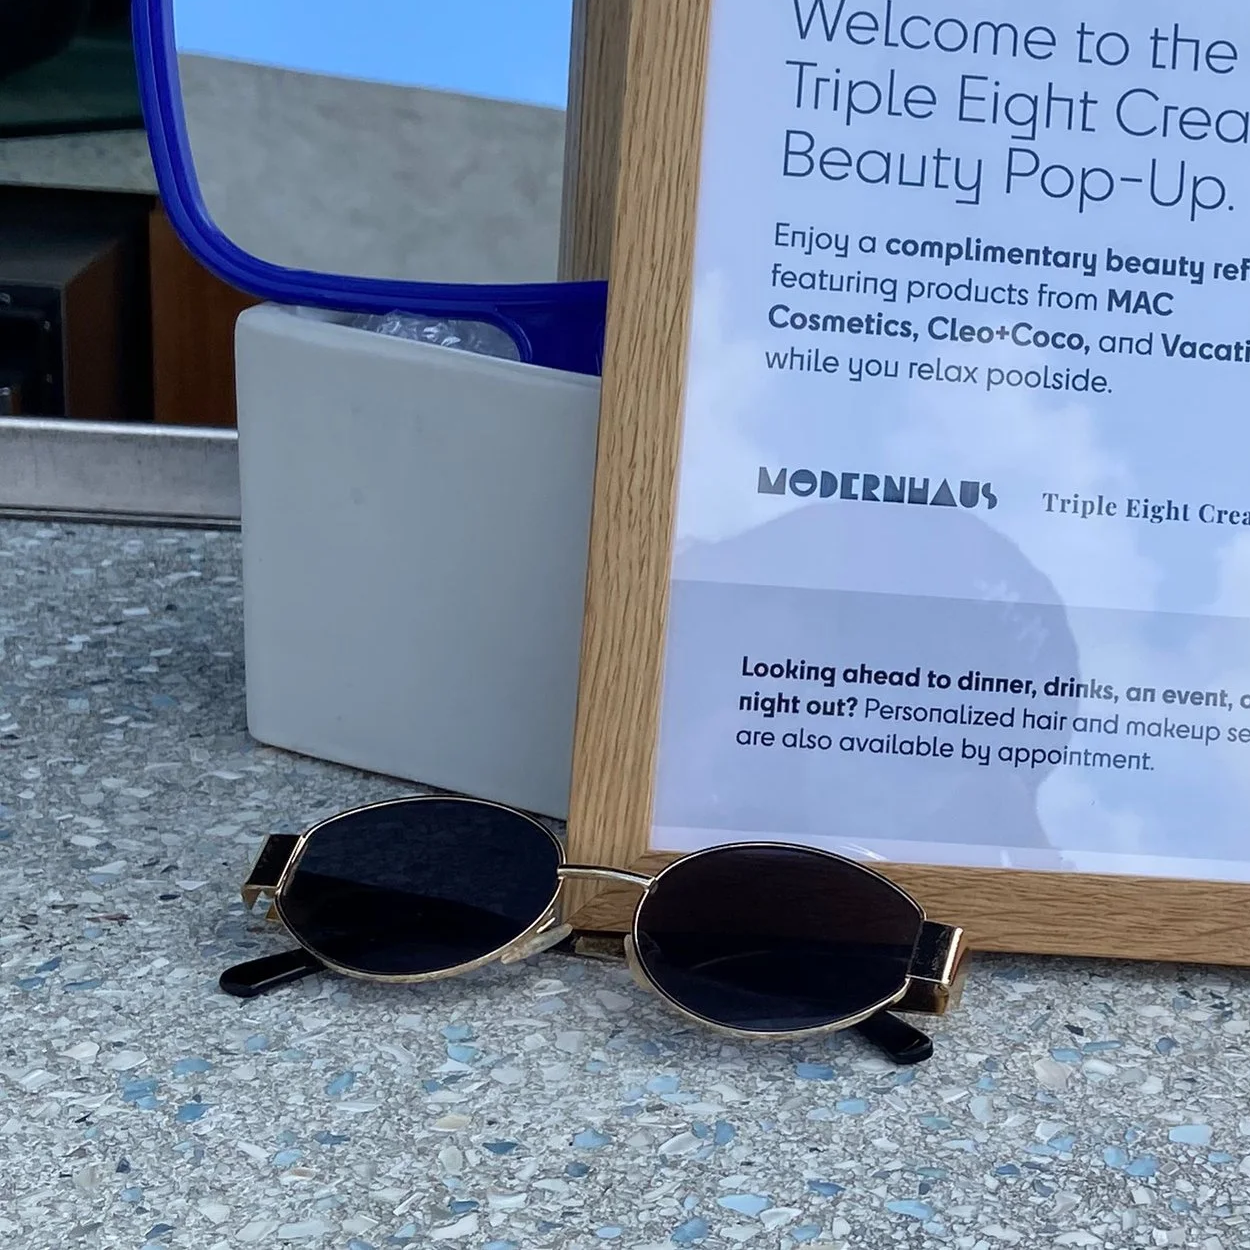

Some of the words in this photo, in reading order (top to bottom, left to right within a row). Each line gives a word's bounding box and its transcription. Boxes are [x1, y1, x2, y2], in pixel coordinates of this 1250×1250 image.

[1076, 22, 1129, 66] to
[1150, 23, 1238, 74] the
[785, 60, 937, 126] Triple
[958, 74, 1098, 141] Eight
[783, 129, 982, 205] Beauty
[1006, 143, 1234, 222] Pop-Up.
[775, 222, 849, 258] Enjoy
[858, 235, 876, 253] a
[885, 236, 1098, 278] complimentary
[1105, 247, 1204, 285] beauty
[771, 263, 897, 303] featuring
[907, 276, 1029, 308] products
[1034, 283, 1097, 311] from
[1107, 287, 1174, 316] MAC
[768, 304, 922, 343] Cosmetics,
[927, 312, 1094, 356] Cleo+Coco,
[1098, 332, 1153, 355] and
[765, 346, 839, 373] while
[849, 357, 899, 382] you
[909, 357, 979, 384] relax
[987, 365, 1112, 393] poolside.
[757, 466, 998, 510] MODERNHAUS
[1042, 492, 1117, 519] Triple
[1126, 497, 1190, 524] Eight
[741, 656, 836, 688] Looking
[842, 664, 920, 688] ahead
[927, 671, 952, 690] to
[958, 672, 1037, 698] dinner,
[1044, 677, 1120, 703] drinks,
[1126, 687, 1156, 702] an
[1162, 689, 1233, 712] event,
[740, 693, 800, 720] night
[807, 697, 858, 720] out?
[864, 699, 1015, 730] Personalized
[1022, 708, 1067, 732] hair
[1072, 713, 1118, 735] and
[1126, 717, 1221, 746] makeup
[736, 730, 775, 748] are
[783, 730, 833, 750] also
[839, 734, 954, 760] available
[961, 741, 990, 765] by
[997, 746, 1154, 771] appointment.
